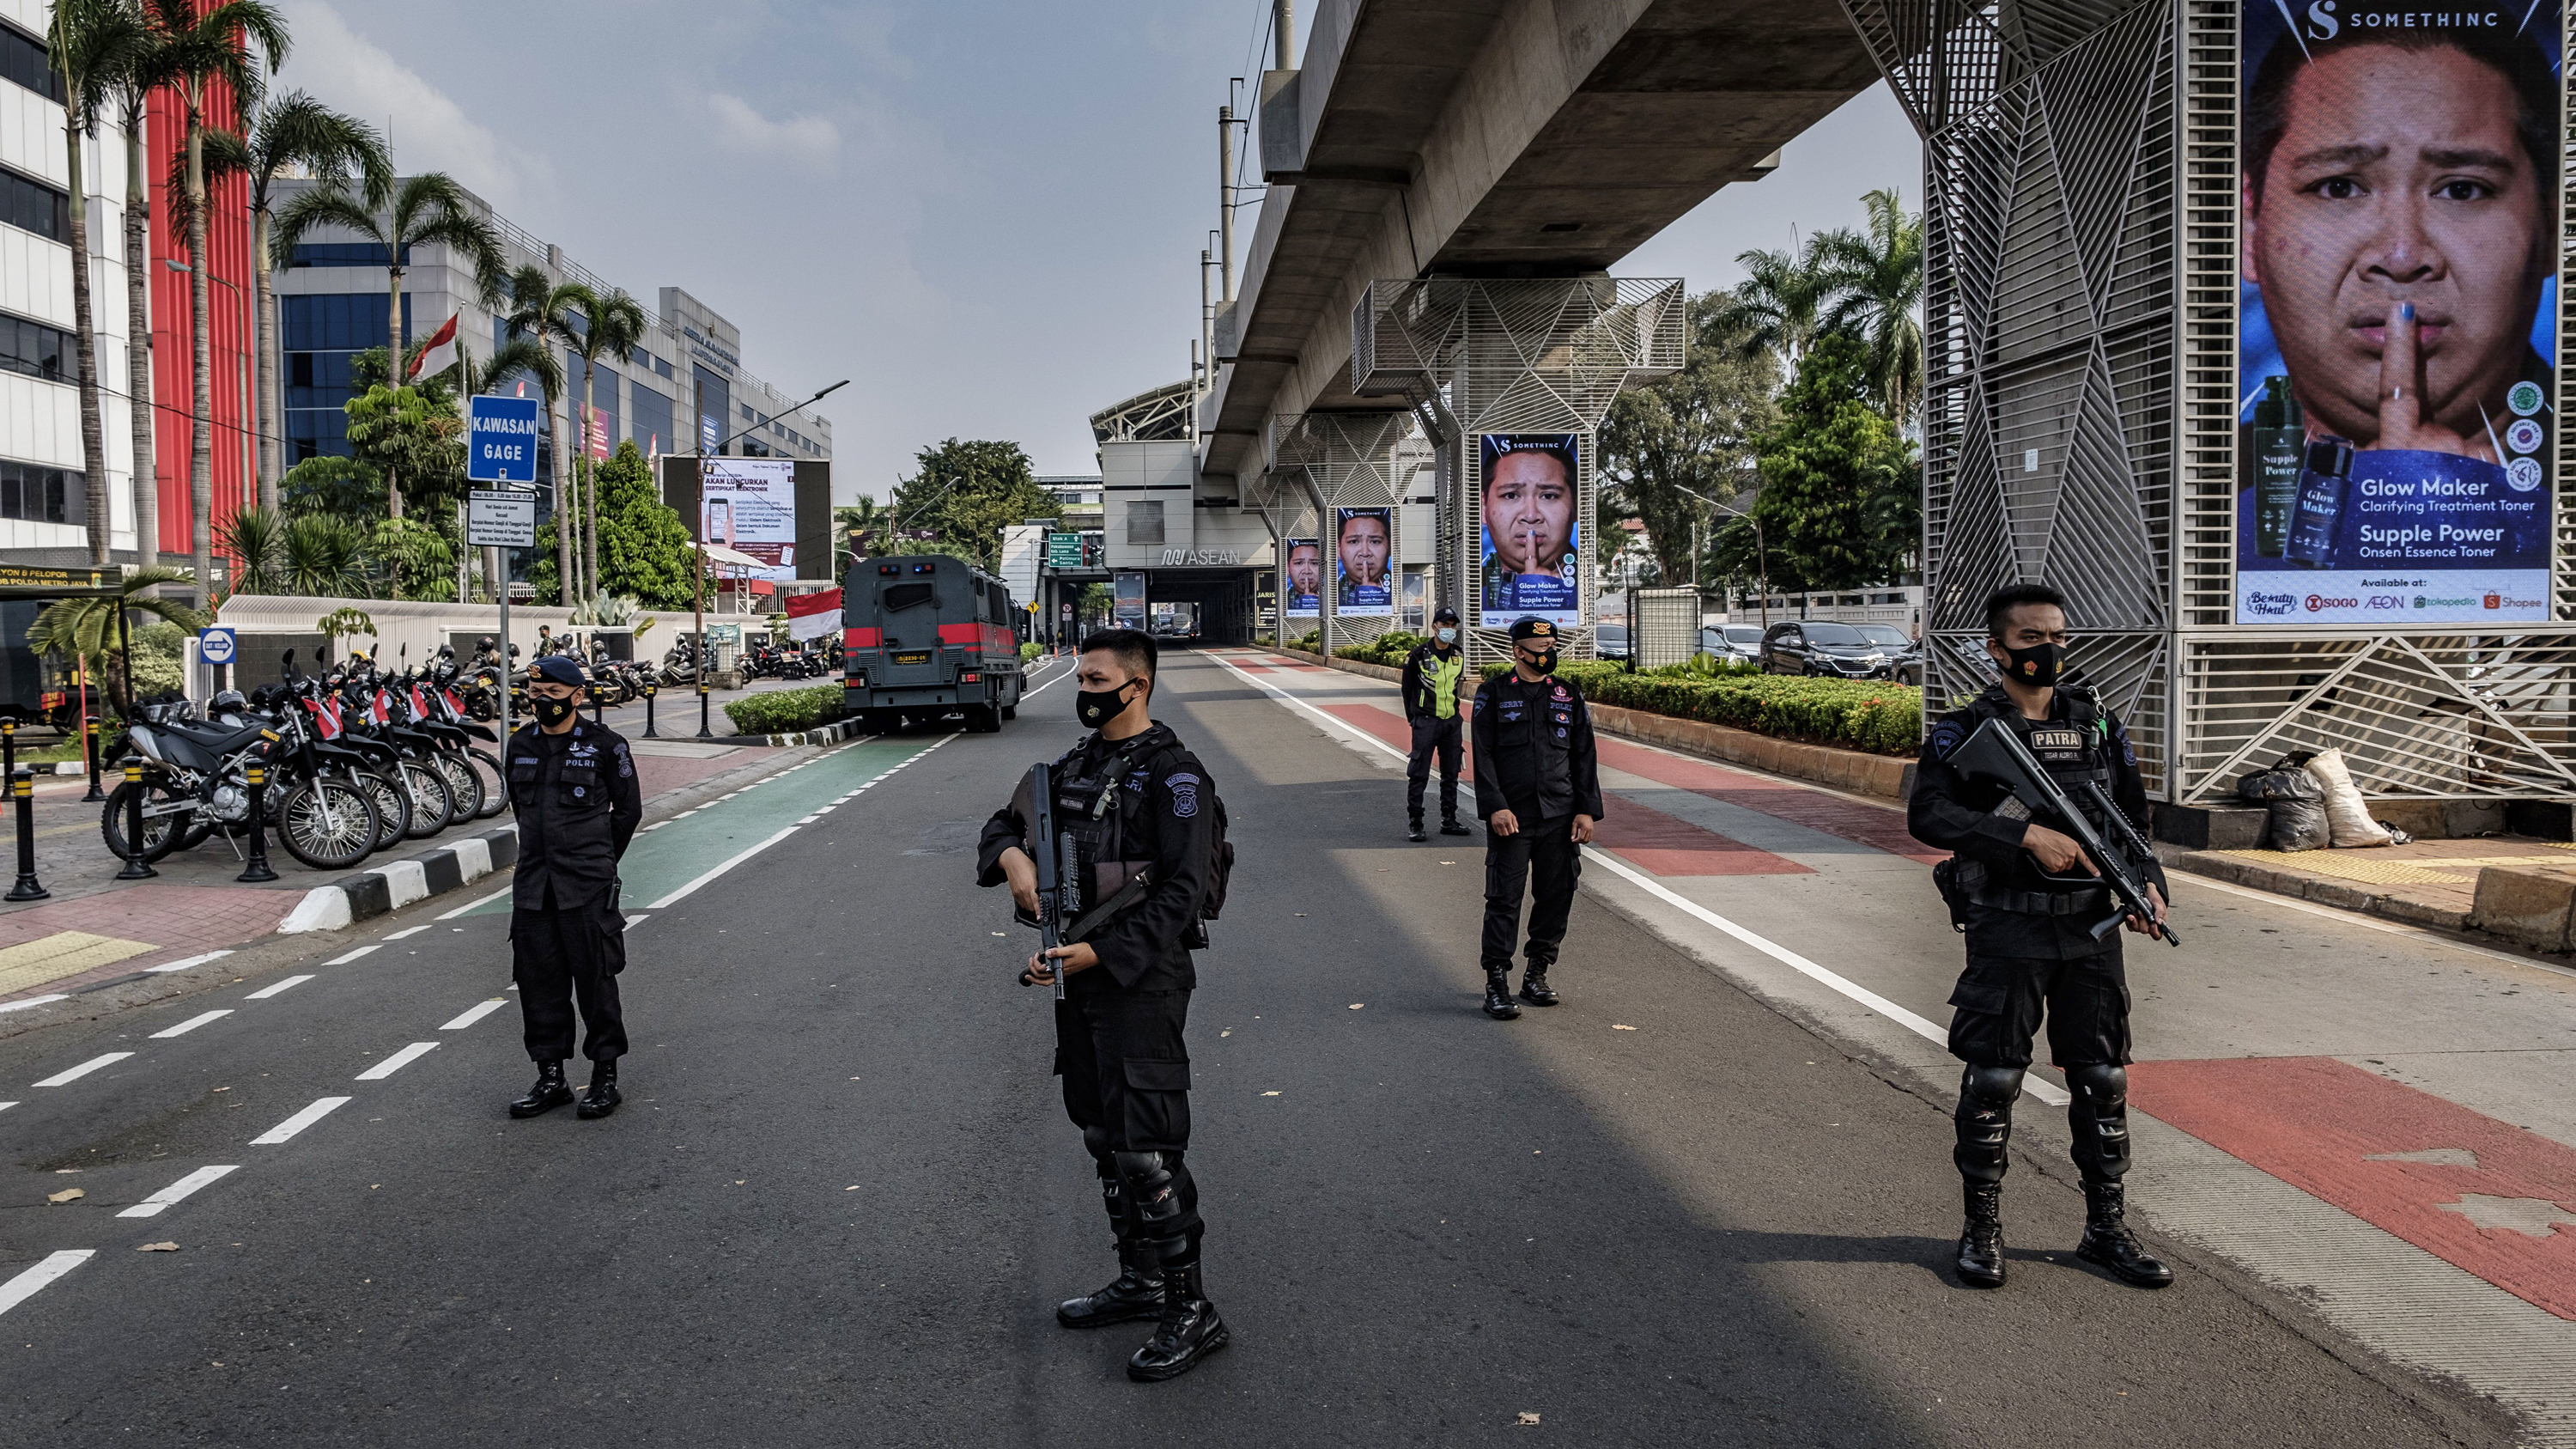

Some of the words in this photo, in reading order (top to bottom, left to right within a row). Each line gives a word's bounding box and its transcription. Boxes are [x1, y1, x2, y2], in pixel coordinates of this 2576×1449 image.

[2351, 12, 2498, 27] SOMETHINC
[472, 417, 534, 435] KAWASAN
[484, 443, 522, 460] GAGE
[2263, 454, 2299, 465] Supple
[2265, 466, 2297, 476] Power
[2361, 478, 2415, 496] Glow
[2421, 478, 2489, 496] Maker
[2306, 490, 2336, 503] Glow
[2302, 500, 2336, 515] Maker
[2360, 501, 2425, 514] Clarifying
[2427, 500, 2496, 512] Treatment
[2499, 500, 2536, 512] Toner
[2360, 524, 2433, 546] Supple
[2439, 524, 2505, 541] Power
[1187, 550, 1240, 565] ASEAN
[2360, 546, 2402, 557] Onsen
[2405, 546, 2458, 557] Essence
[2459, 545, 2496, 557] Toner
[2361, 579, 2409, 588] Available
[2323, 598, 2358, 608] SOGO
[2427, 596, 2476, 606] tokopedia
[2502, 597, 2542, 610] Shopee
[1550, 703, 1572, 711] POLRI
[2035, 733, 2079, 746] PATRA
